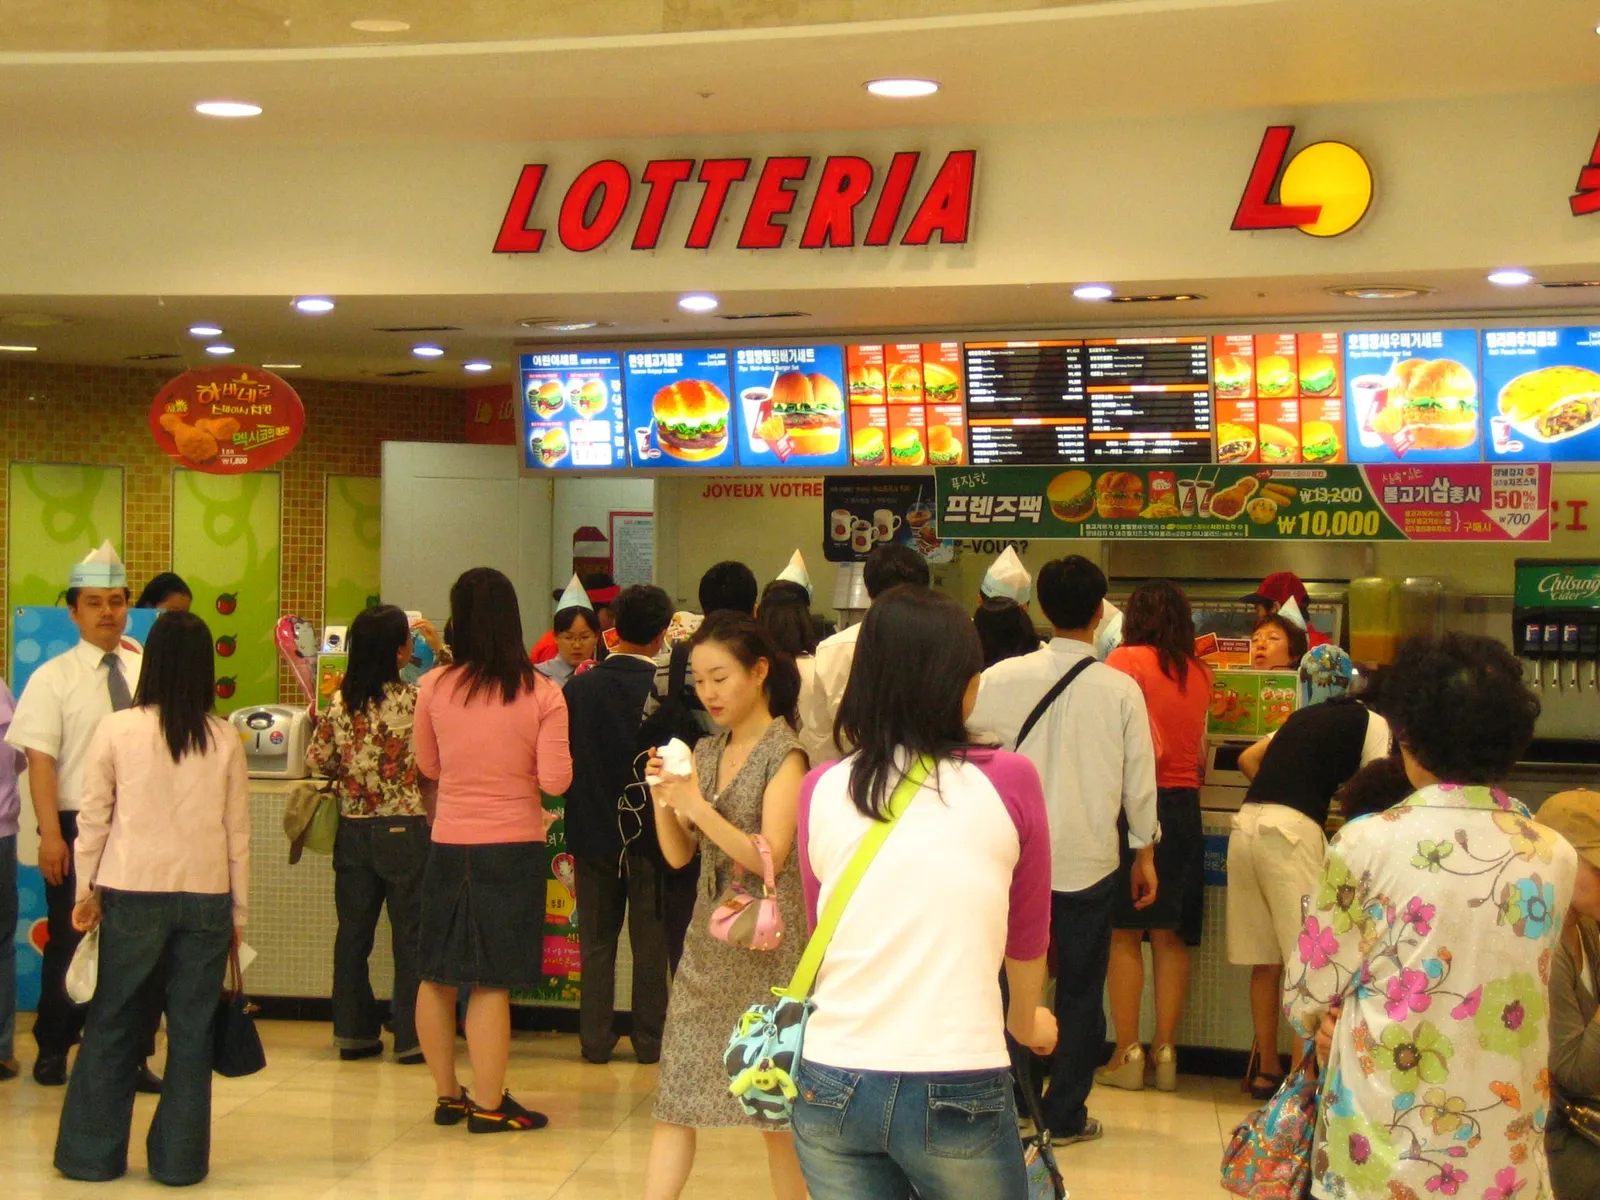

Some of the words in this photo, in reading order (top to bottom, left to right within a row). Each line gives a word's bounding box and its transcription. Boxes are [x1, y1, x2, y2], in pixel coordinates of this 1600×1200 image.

[492, 149, 977, 254] LOTTERIA
[532, 354, 579, 367] 어린이세트
[196, 382, 272, 404] 하바네로
[211, 404, 249, 415] 스파이시
[251, 403, 272, 415] 치킨
[702, 483, 764, 499] JOYEUX
[770, 482, 823, 498] VOTRE
[951, 472, 988, 490] 푸짐한
[1384, 477, 1482, 504] 불고기삼총사
[944, 495, 1042, 524] 프렌즈팩
[1277, 510, 1380, 537] ₩10,000
[1538, 573, 1600, 598] Chilsung
[1551, 591, 1580, 600] Cider
